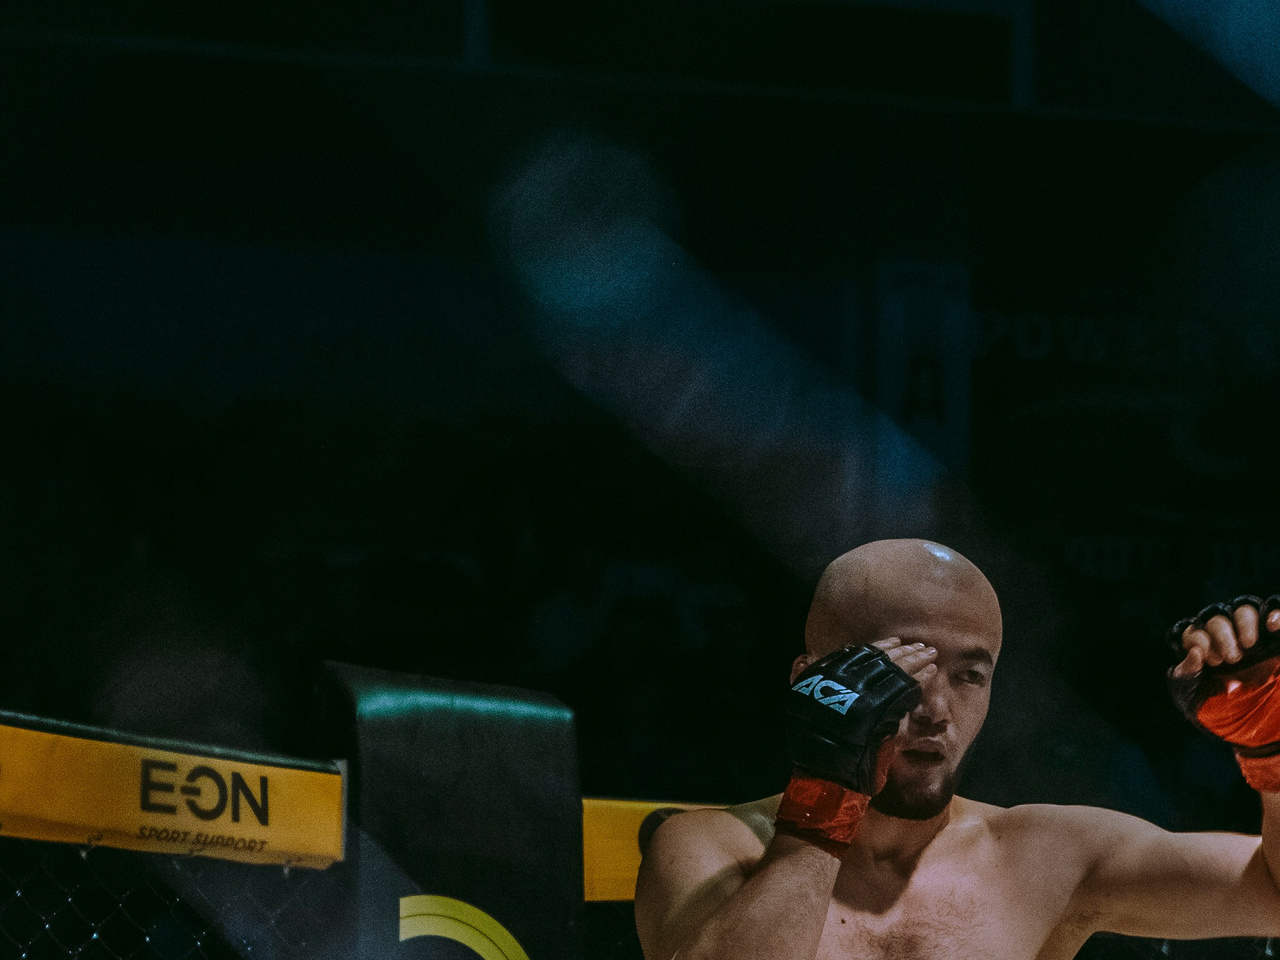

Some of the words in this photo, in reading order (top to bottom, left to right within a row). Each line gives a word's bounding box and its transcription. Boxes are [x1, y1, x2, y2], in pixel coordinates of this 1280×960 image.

[791, 674, 860, 715] ACA
[137, 826, 190, 844] SPORT
[191, 832, 268, 853] SUPPORT
